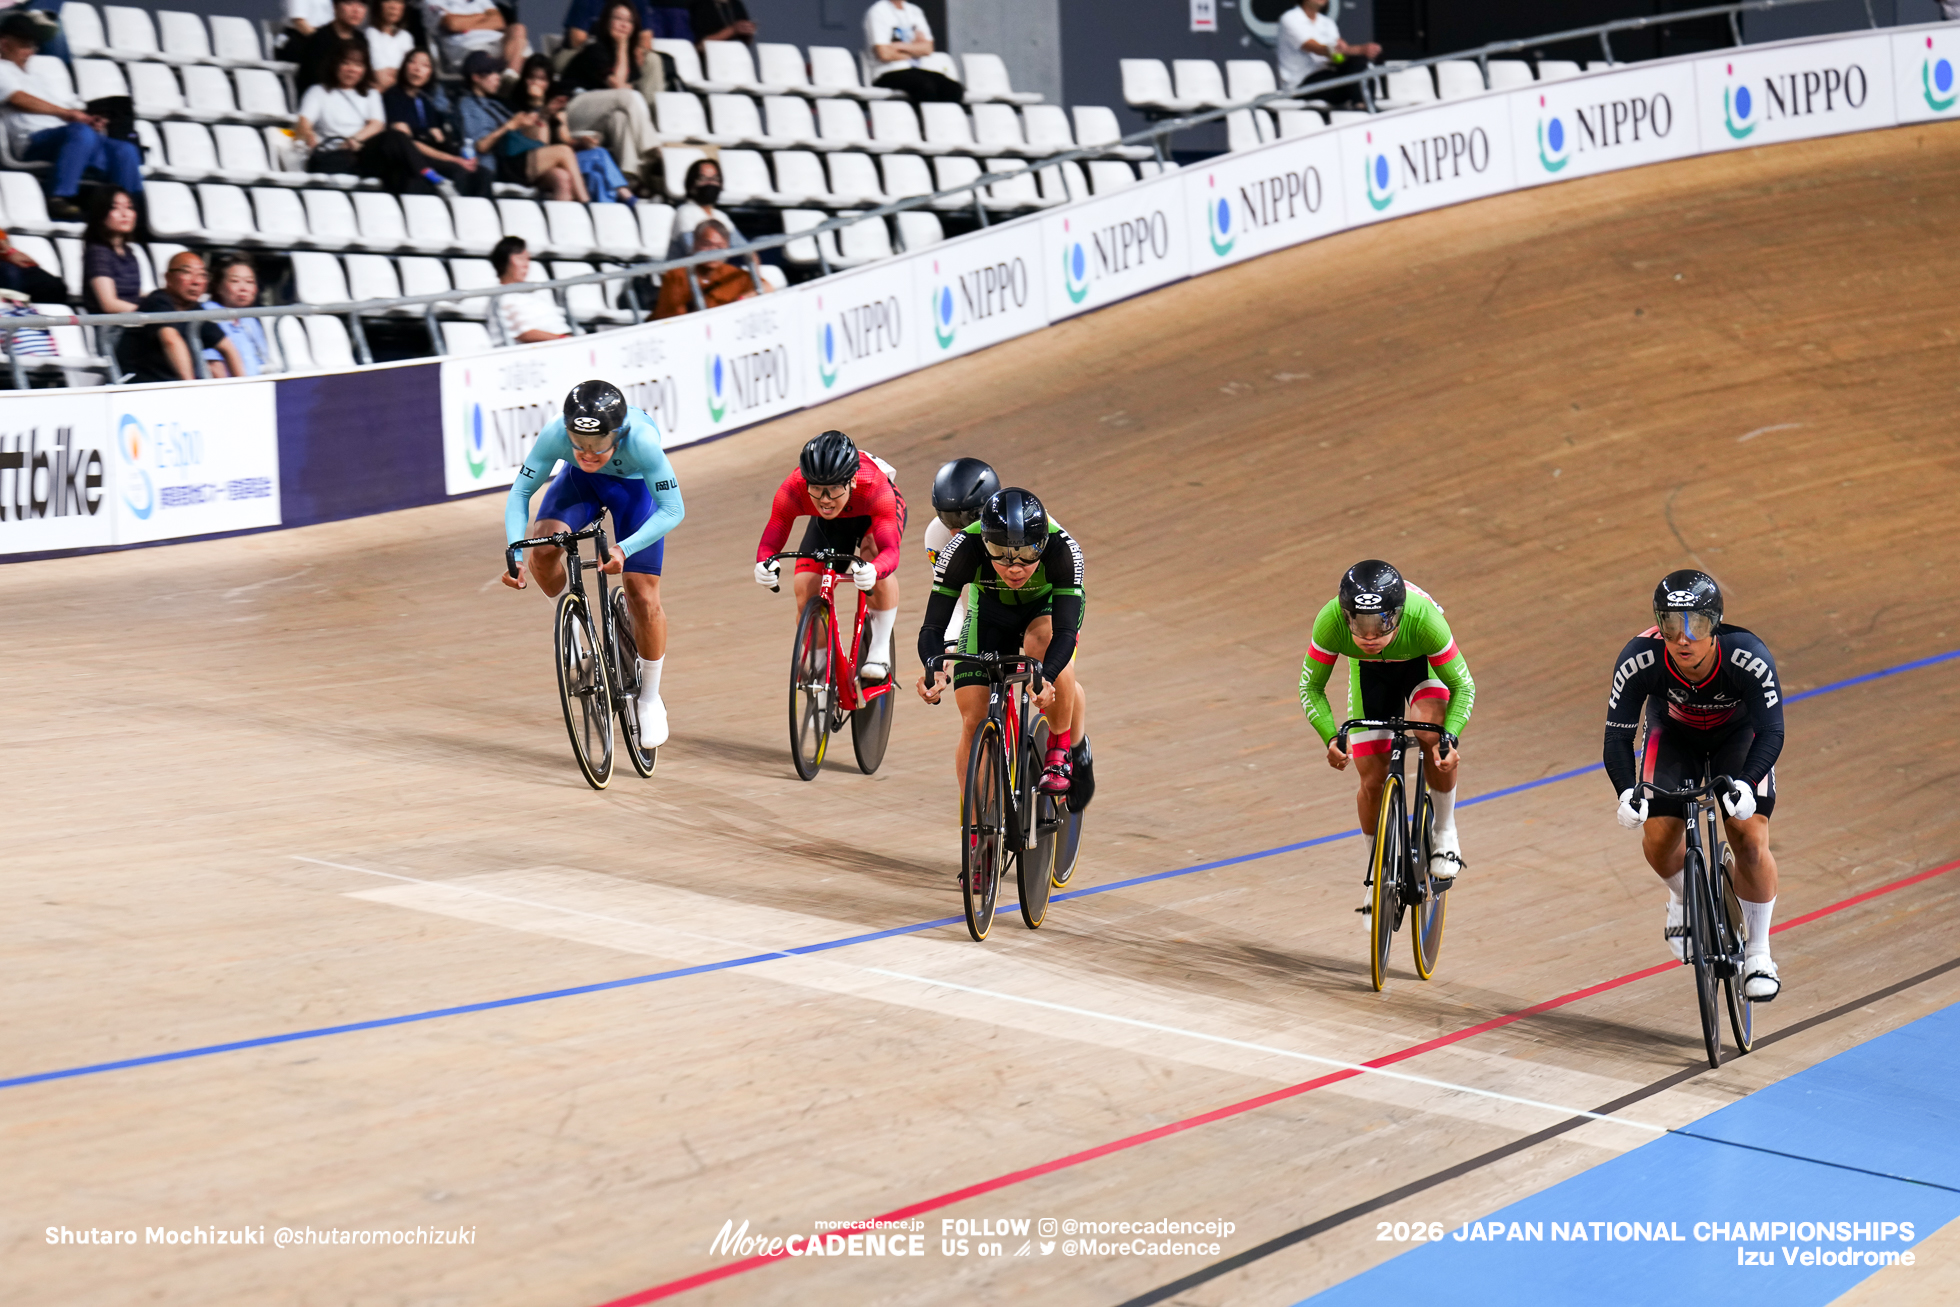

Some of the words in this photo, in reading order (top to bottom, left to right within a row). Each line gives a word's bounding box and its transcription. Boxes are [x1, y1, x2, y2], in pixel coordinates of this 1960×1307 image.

[1576, 93, 1672, 152] NIPPO
[1764, 64, 1868, 120] NIPPO
[1399, 126, 1490, 190] NIPPO
[1241, 165, 1322, 234] NIPPO
[1092, 210, 1168, 280] NIPPO
[959, 257, 1028, 326] NIPPO
[841, 296, 902, 364] NIPPO
[729, 344, 788, 414] NIPPO
[1608, 649, 1655, 709] HODO
[1730, 648, 1779, 709] GAYA
